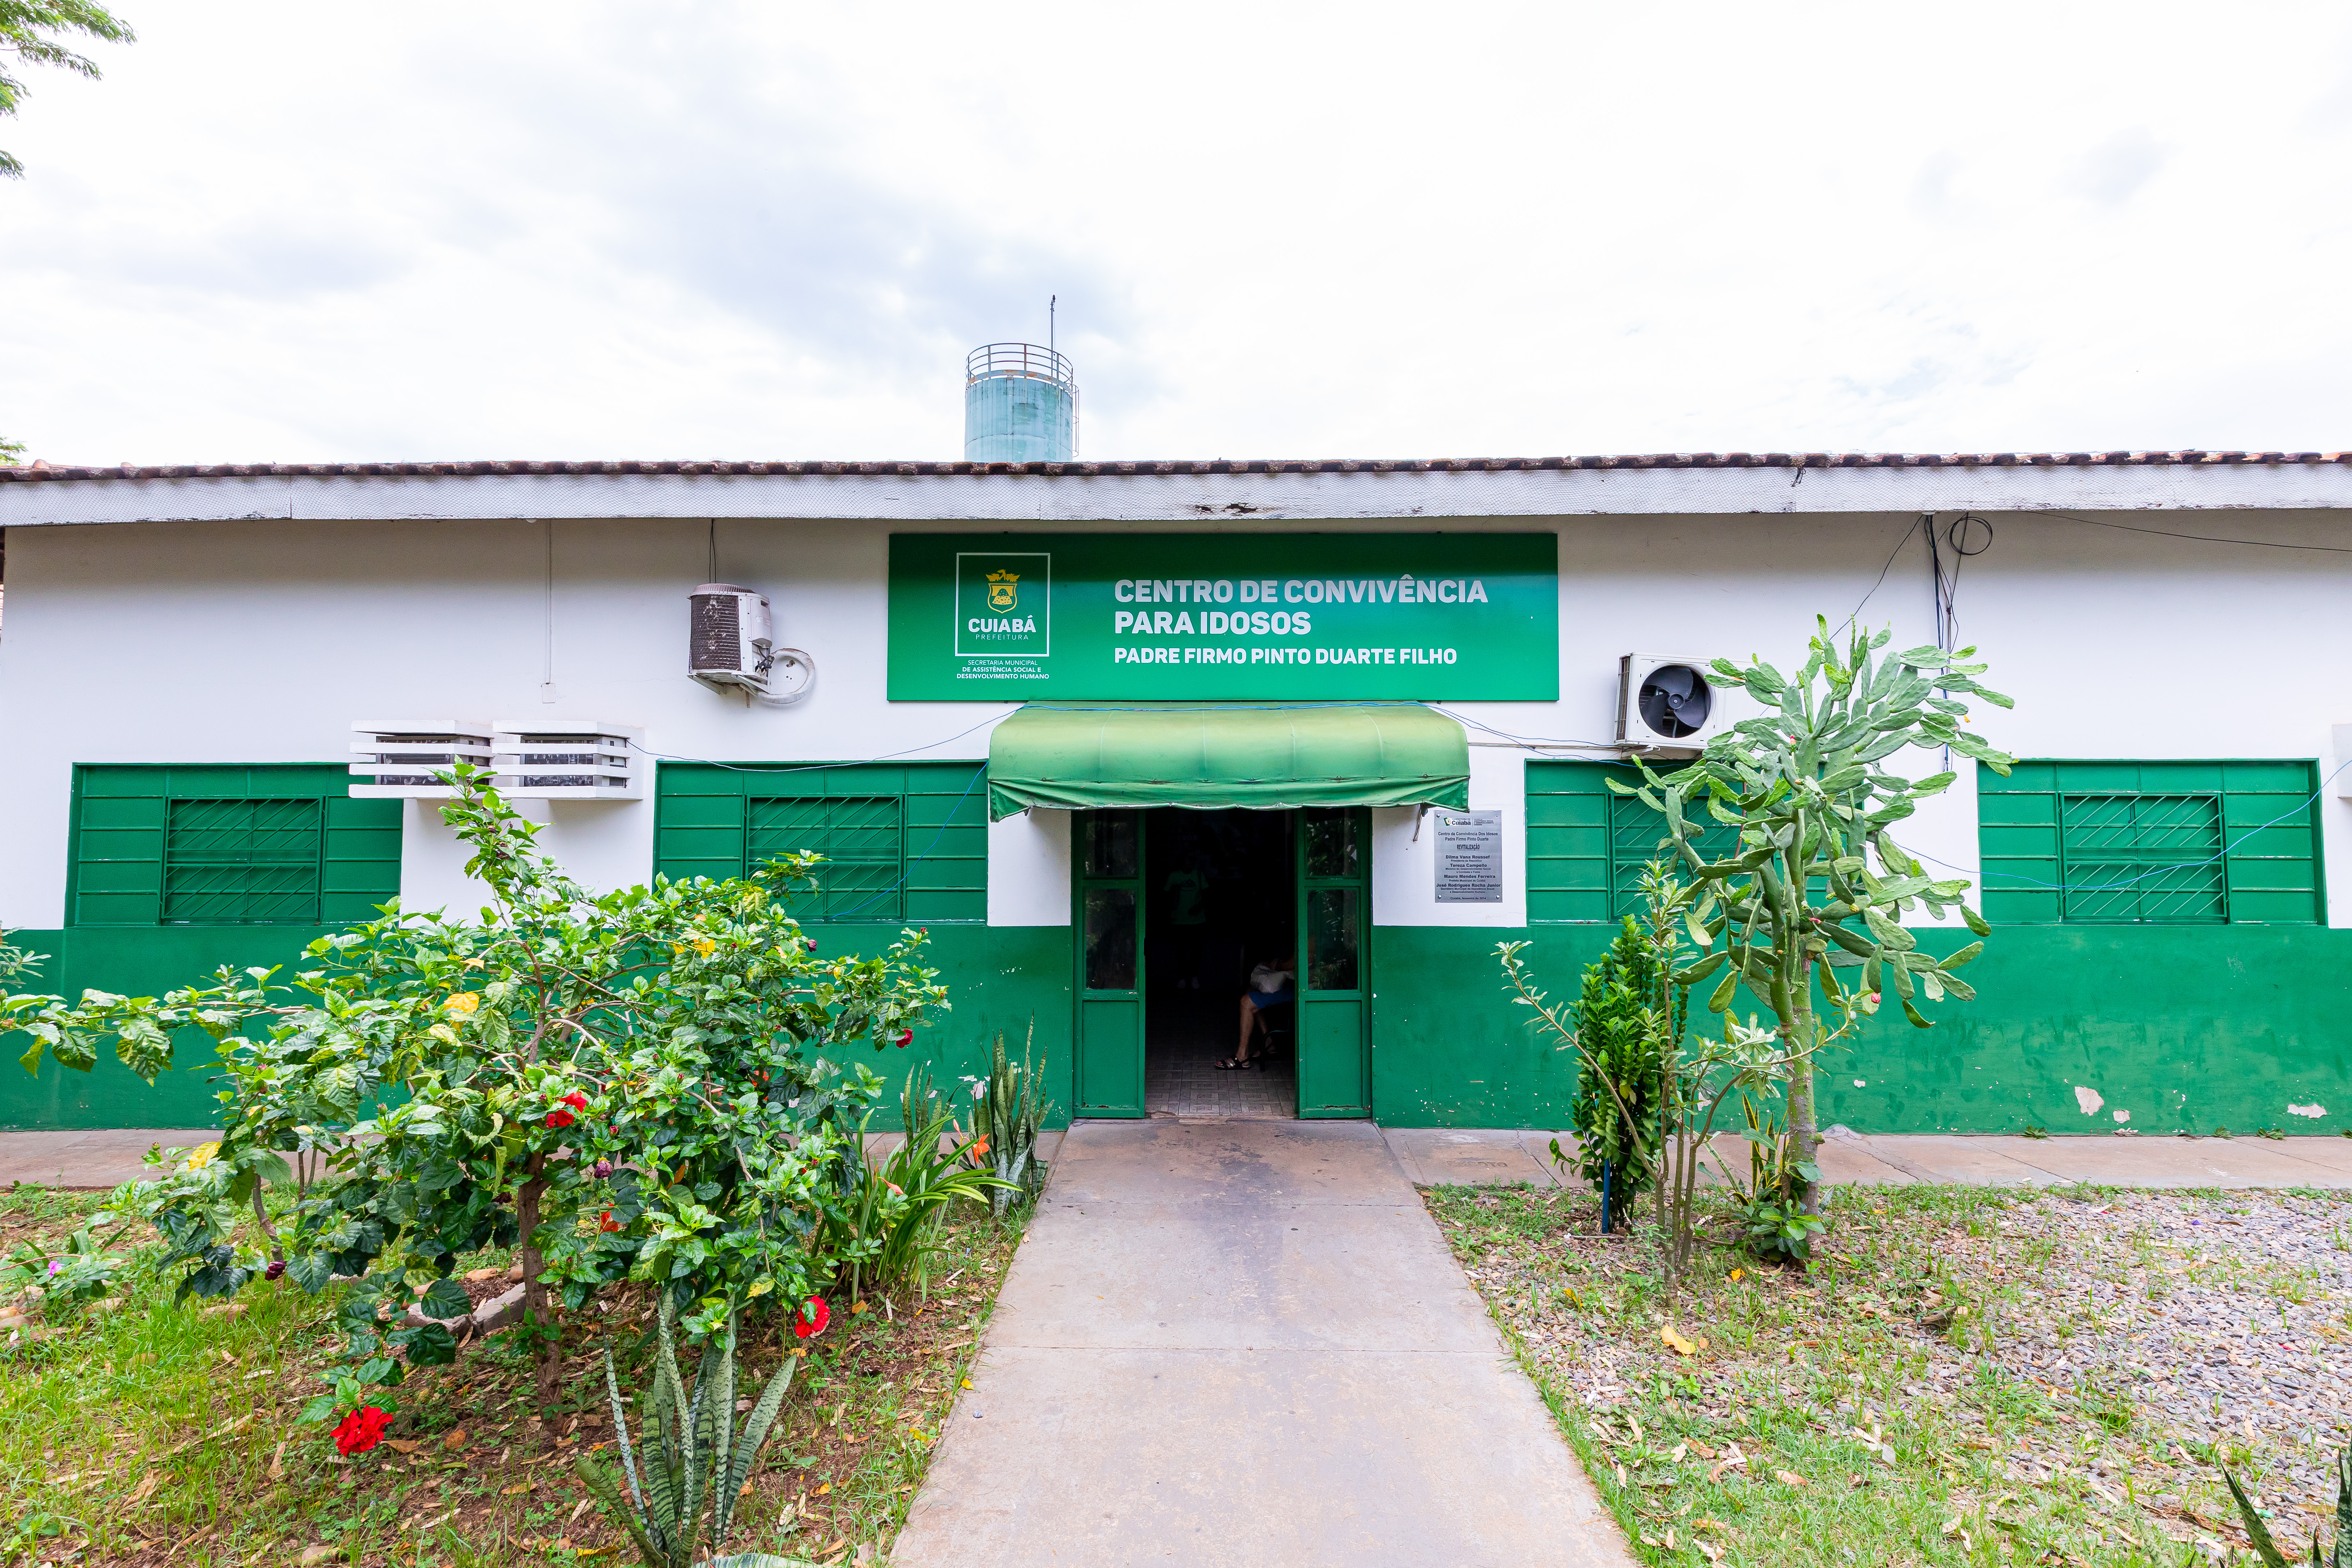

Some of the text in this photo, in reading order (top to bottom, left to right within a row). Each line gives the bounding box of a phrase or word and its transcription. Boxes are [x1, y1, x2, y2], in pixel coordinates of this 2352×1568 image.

[1115, 574, 1488, 603] CENTRO DE CONVIVÊNCIA
[968, 614, 1036, 633] CUIABÁ
[1115, 611, 1311, 635] PARA IDOSOS
[1115, 648, 1457, 664] PADRE FIRMO PINTO DUARTE FILHO
